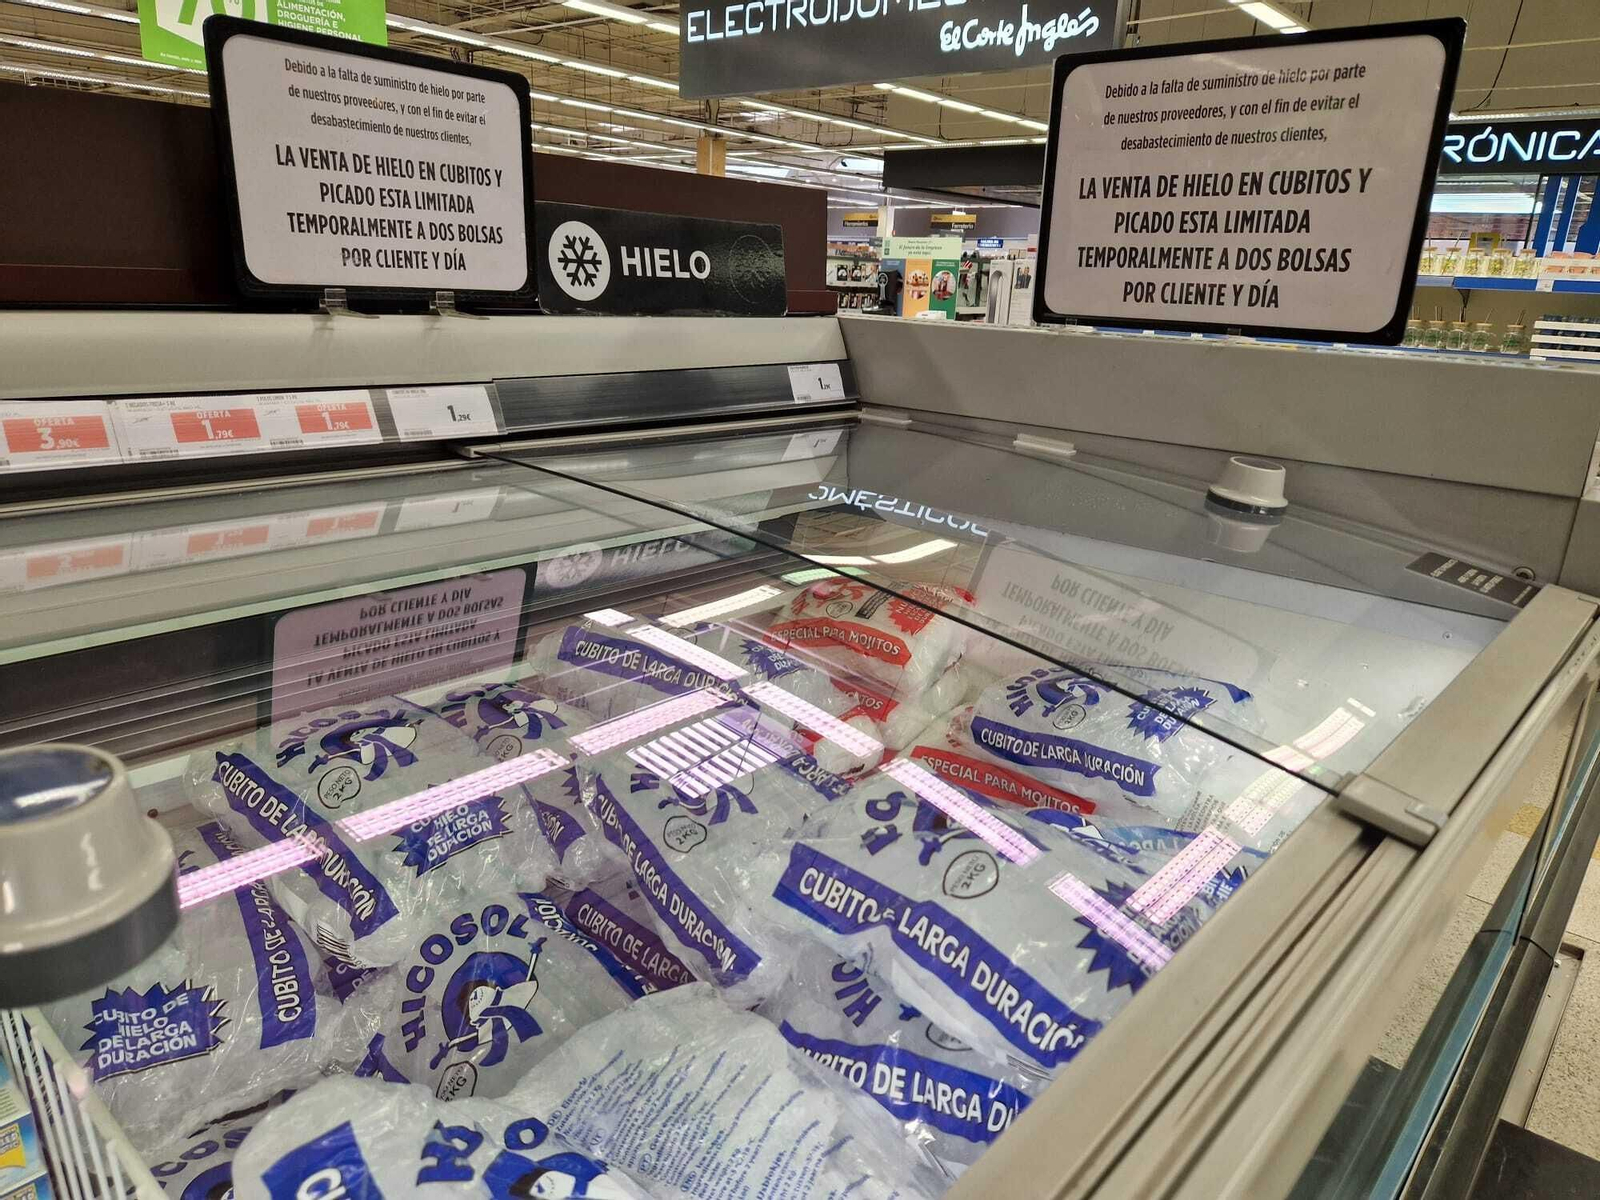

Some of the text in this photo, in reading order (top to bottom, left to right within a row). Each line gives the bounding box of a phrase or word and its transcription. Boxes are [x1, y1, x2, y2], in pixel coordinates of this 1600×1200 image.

[277, 10, 339, 29] DROGUERÍA E
[939, 3, 1100, 57] El Corte Inglés
[285, 58, 486, 104] Debido a la falta de suministro de hielo por parte
[1105, 63, 1366, 99] Debido a la falta de suministro de hielo por parte
[288, 84, 486, 125] de nuestros proveedores, y con el fin de evitar el
[1103, 92, 1360, 125] de nuestros proveedores, y con el fin de evitar el
[310, 112, 472, 146] desabastecimiento de nuestros clientes,
[1121, 126, 1327, 150] desabastecimiento de nuestros clientes,
[275, 144, 502, 187] LA VENTA DE HIELO EN CUBITOS Y
[319, 182, 475, 214] PICADO ESTA LIMITADA
[1079, 168, 1373, 200] LA VENTA DE HIELO EN CUBITOS Y
[286, 212, 503, 244] TEMPORALMENTE A DOS BOLSAS
[1114, 209, 1311, 234] PICADO ESTA LIMITADA
[341, 247, 467, 271] POR CLIENTE Y DÍA
[620, 246, 711, 280] HIELO
[1078, 246, 1352, 272] TEMPORALMENTE A DOS BOLSAS
[1123, 278, 1279, 308] POR CLIENTE Y DÍA
[196, 410, 231, 419] OFERTA
[849, 629, 901, 656] MOJITOS
[575, 640, 682, 684] CUBITO DE LARGA
[981, 728, 1023, 755] CUBITO
[1022, 738, 1039, 759] DE
[1040, 741, 1081, 765] LARGA
[218, 761, 265, 808] CUBITO
[259, 797, 288, 826] DE
[984, 773, 1017, 795] PARA
[1021, 786, 1081, 814] MOJITOS
[634, 851, 668, 906] LARGA
[577, 903, 623, 946] CUBITO
[622, 933, 643, 961] DE
[799, 867, 881, 923] CUBITO
[898, 907, 971, 978] LARGA
[264, 928, 302, 1023] CUBITO DE
[401, 904, 529, 1053] HICOSOL
[94, 992, 189, 1025] CUBITO DE
[872, 1063, 906, 1101] DE
[912, 1071, 983, 1124] LARGA
